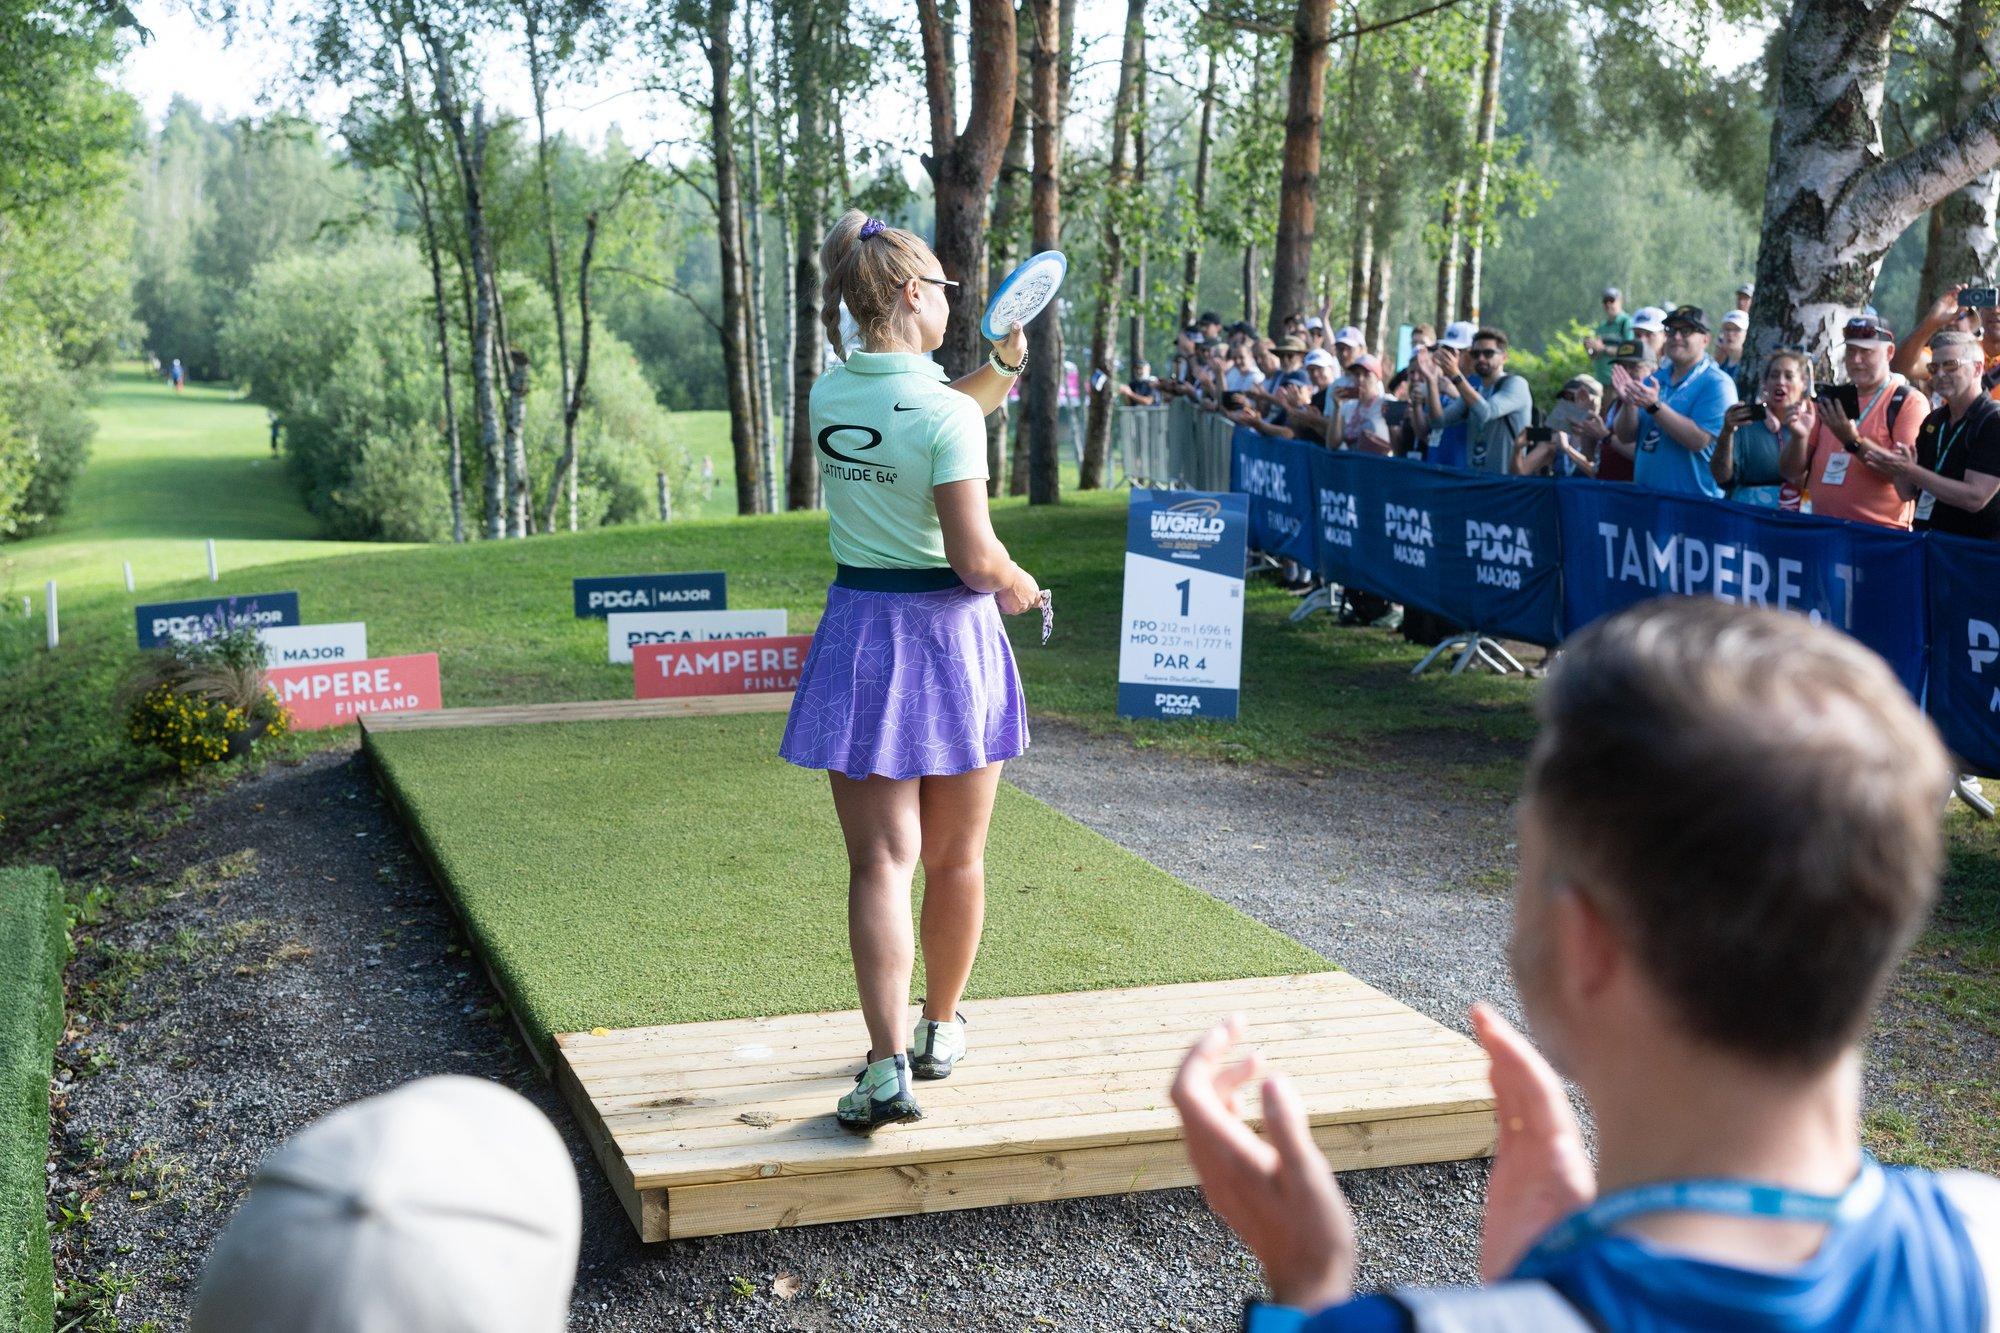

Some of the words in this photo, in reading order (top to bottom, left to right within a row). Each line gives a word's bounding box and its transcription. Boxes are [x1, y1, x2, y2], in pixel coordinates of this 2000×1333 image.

[820, 461, 872, 482] LATITUDE
[1319, 488, 1359, 529] PDGA
[1150, 514, 1226, 534] WORLD
[1384, 502, 1435, 548] PDGA
[1324, 526, 1353, 547] MAJOR
[1465, 519, 1534, 568] PDGA
[1393, 543, 1427, 568] MAJOR
[1475, 564, 1522, 590] MAJOR
[588, 589, 649, 609] PDGA
[659, 588, 711, 603] MAJOR
[1175, 578, 1190, 617] 1
[1132, 620, 1157, 631] FPO
[1160, 622, 1178, 633] 212
[1199, 625, 1221, 635] 696
[1130, 634, 1158, 645] MPO
[1161, 636, 1181, 646] 237
[1203, 639, 1222, 649] 777
[283, 646, 345, 660] MAJOR
[1154, 653, 1189, 669] PAR
[1195, 657, 1207, 670] 4
[266, 668, 402, 703] AMPERE.
[744, 676, 799, 690] FINLA
[335, 695, 419, 715] FINLAND
[1155, 693, 1201, 708] PDGA
[1161, 706, 1193, 715] MAJOR
